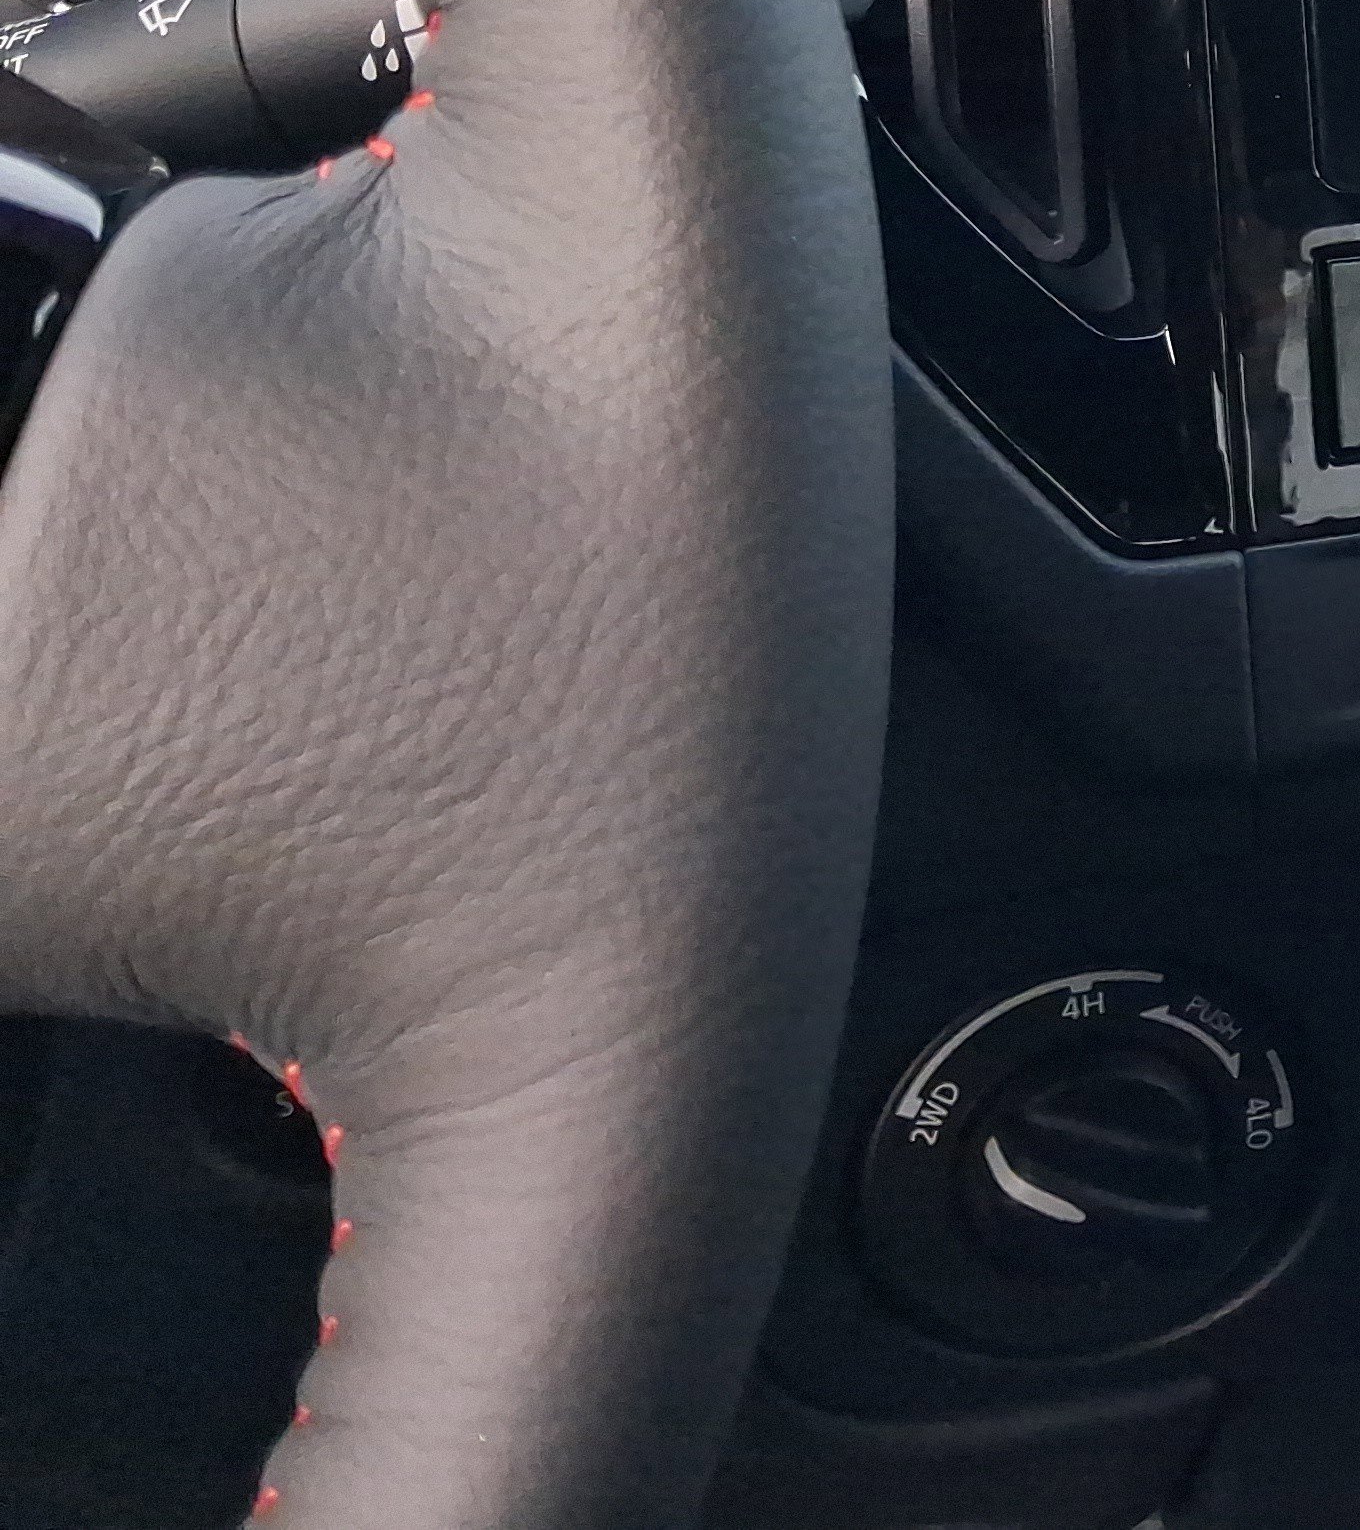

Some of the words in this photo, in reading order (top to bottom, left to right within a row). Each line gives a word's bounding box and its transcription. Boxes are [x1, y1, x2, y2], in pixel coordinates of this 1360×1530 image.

[1061, 992, 1106, 1020] 4H
[1185, 995, 1242, 1041] PUSH
[909, 1081, 960, 1146] 2WD
[1244, 1097, 1274, 1151] 4LO
